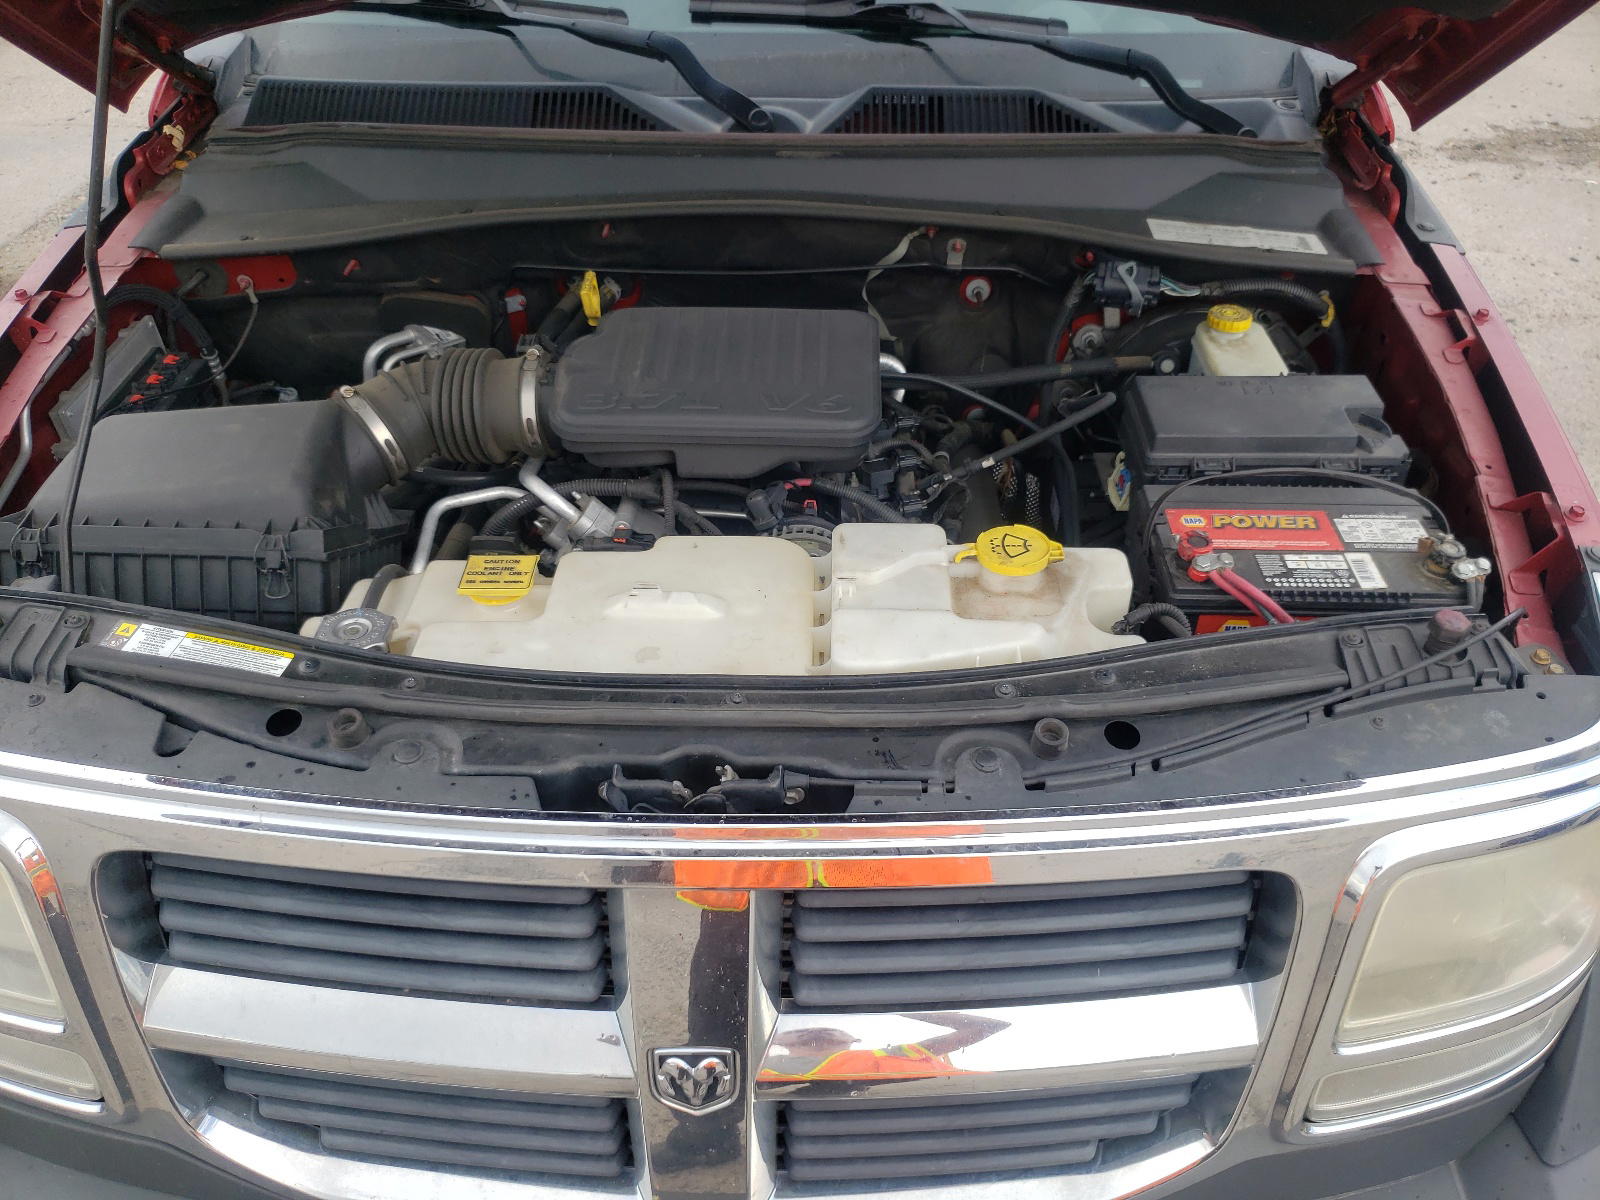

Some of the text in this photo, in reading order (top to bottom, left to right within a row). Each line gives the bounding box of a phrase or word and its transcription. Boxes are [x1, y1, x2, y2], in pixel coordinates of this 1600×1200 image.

[760, 391, 851, 414] V6
[1184, 514, 1317, 529] NAPA POWER
